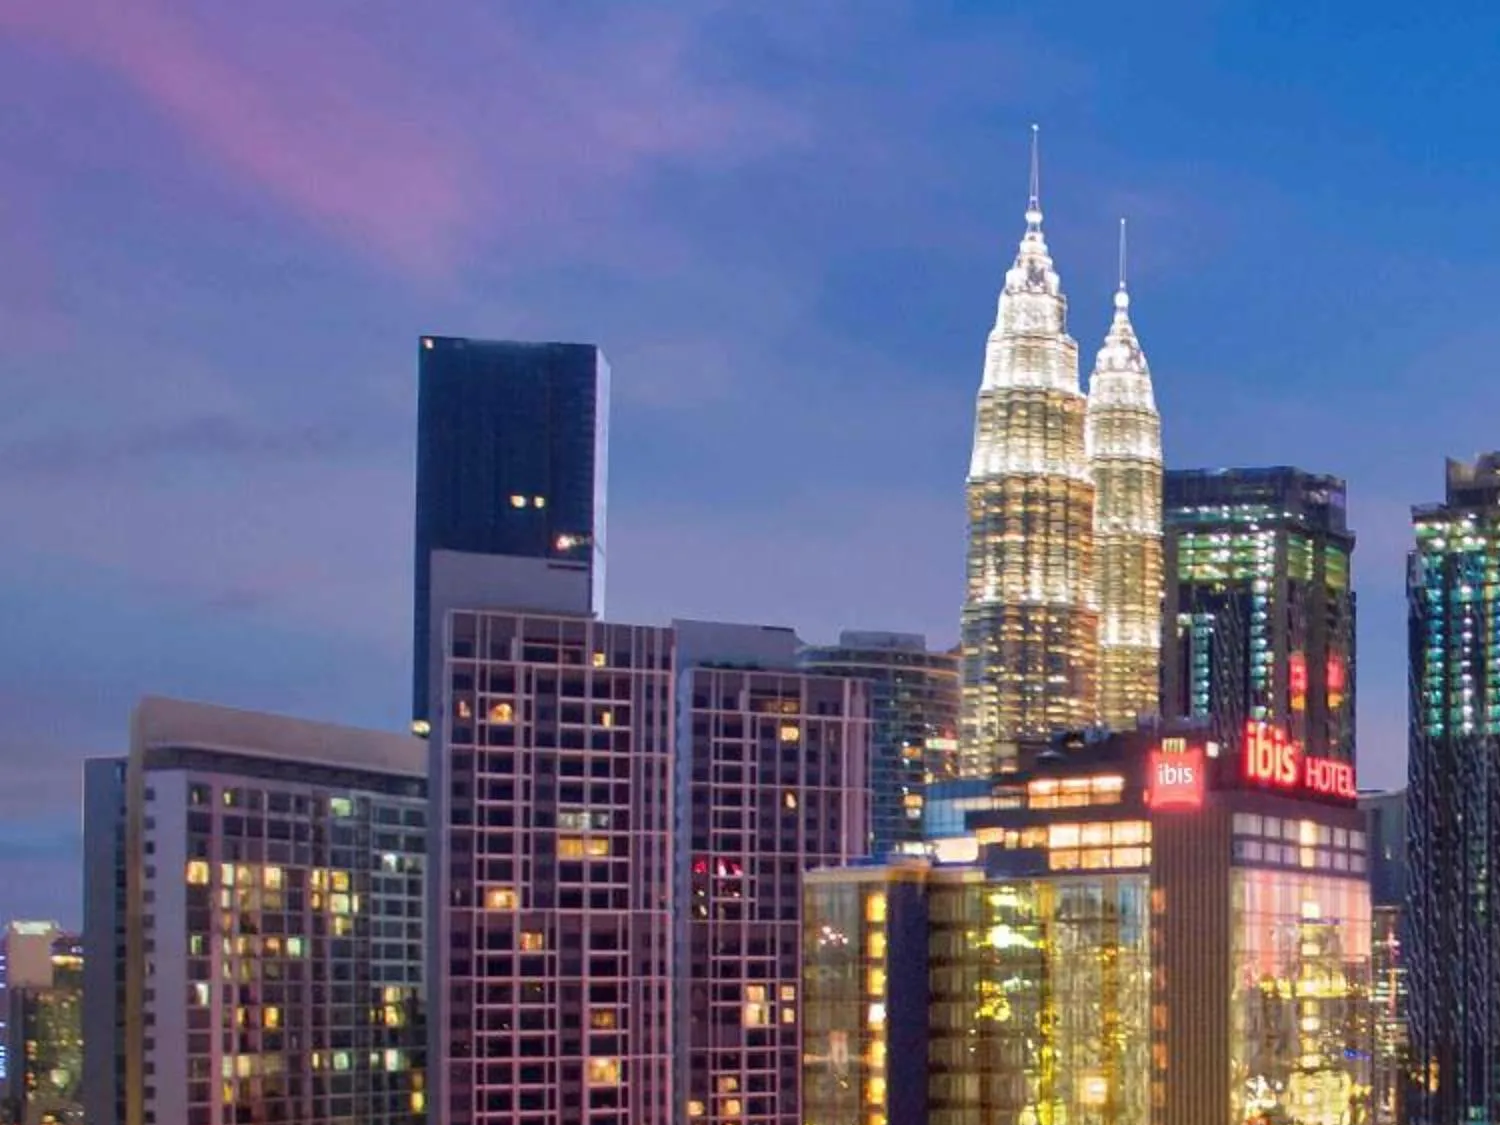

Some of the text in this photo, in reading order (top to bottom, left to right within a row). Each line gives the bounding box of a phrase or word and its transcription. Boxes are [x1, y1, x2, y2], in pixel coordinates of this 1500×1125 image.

[1158, 761, 1193, 784] ibis
[1247, 721, 1357, 798] ibis HOTEL
